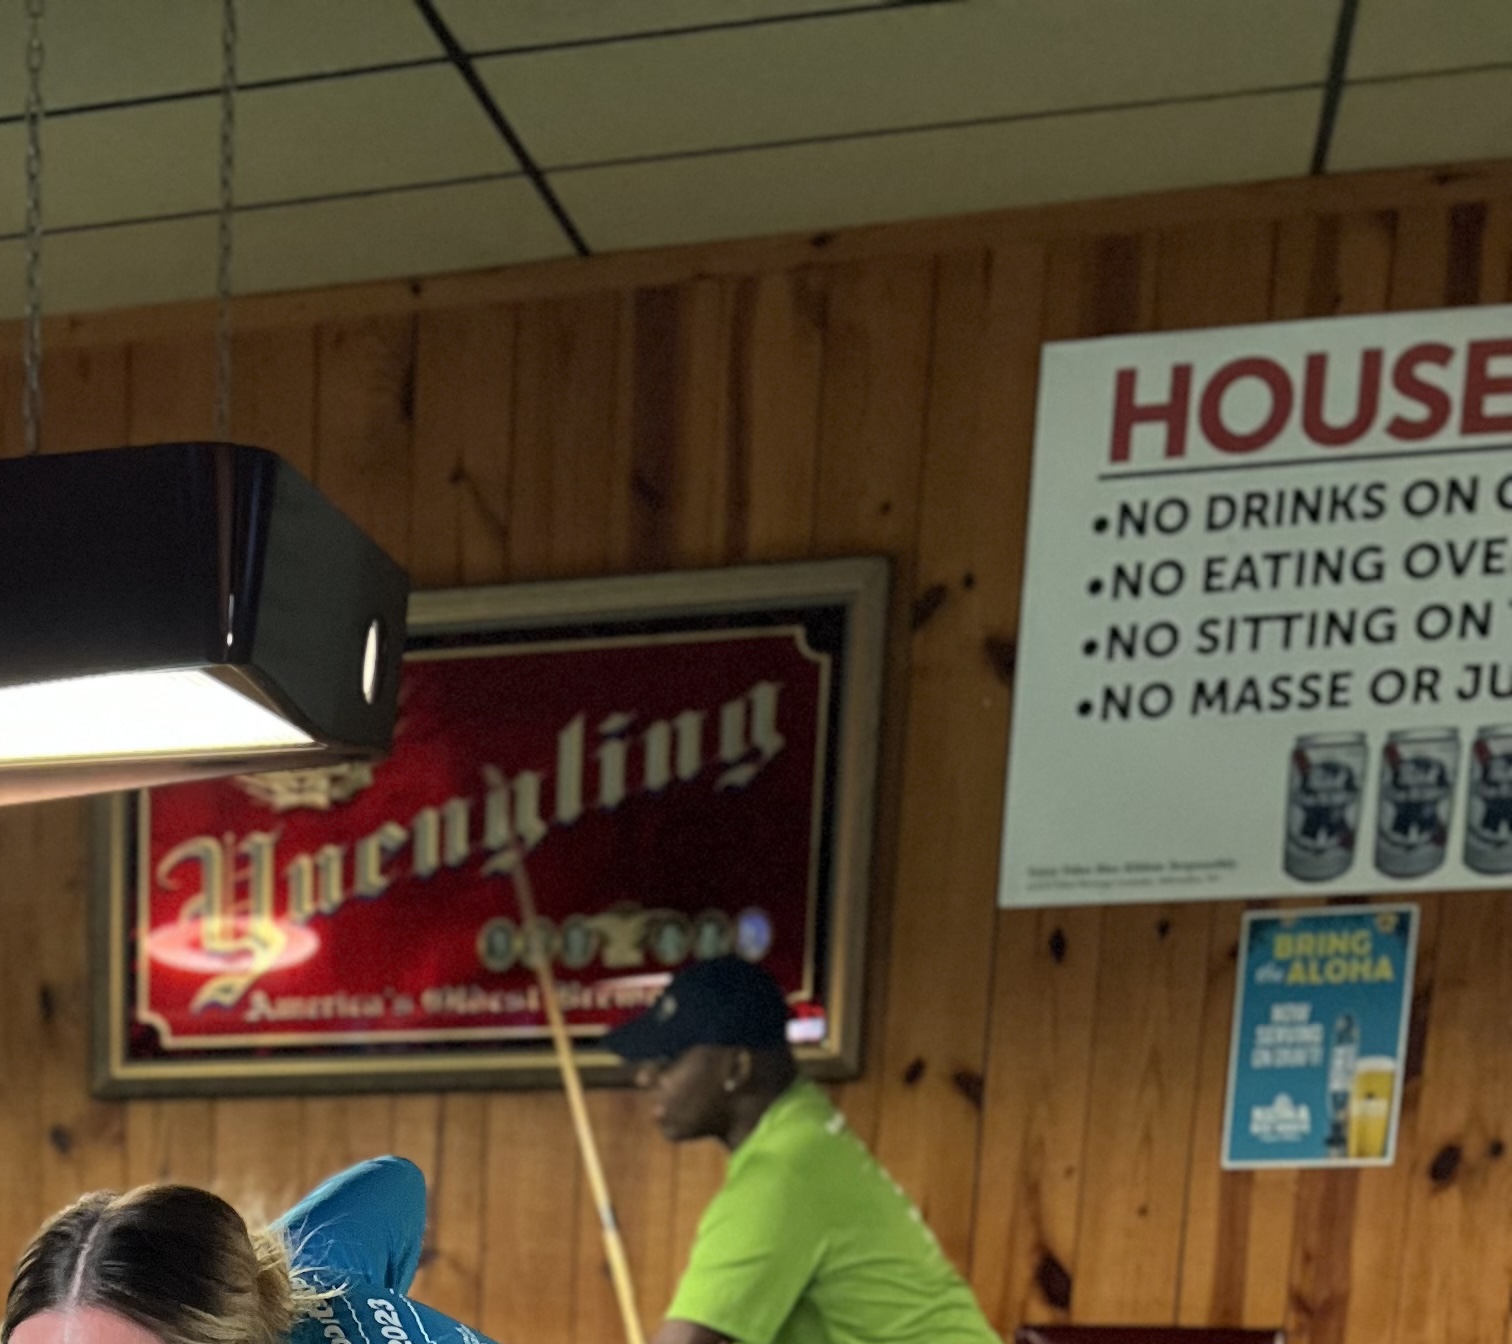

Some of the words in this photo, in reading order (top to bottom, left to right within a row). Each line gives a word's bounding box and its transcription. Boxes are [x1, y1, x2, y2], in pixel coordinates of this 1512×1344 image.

[1108, 339, 1512, 464] HOUSE
[1117, 498, 1190, 538] NO
[1205, 482, 1387, 533] DRINKS
[1402, 477, 1479, 518] ON
[1111, 560, 1185, 600] NO
[1202, 545, 1385, 594] EATING
[1403, 538, 1508, 580] OVE
[1106, 621, 1179, 661] NO
[1196, 607, 1397, 656] SITTING
[1415, 601, 1493, 641] ON
[1101, 682, 1174, 721] NO
[1190, 672, 1352, 716] MASSE
[1369, 667, 1441, 706] OR
[156, 679, 787, 1016] Yuengling
[1274, 930, 1371, 960] BRING
[1286, 955, 1394, 985] ALOHA
